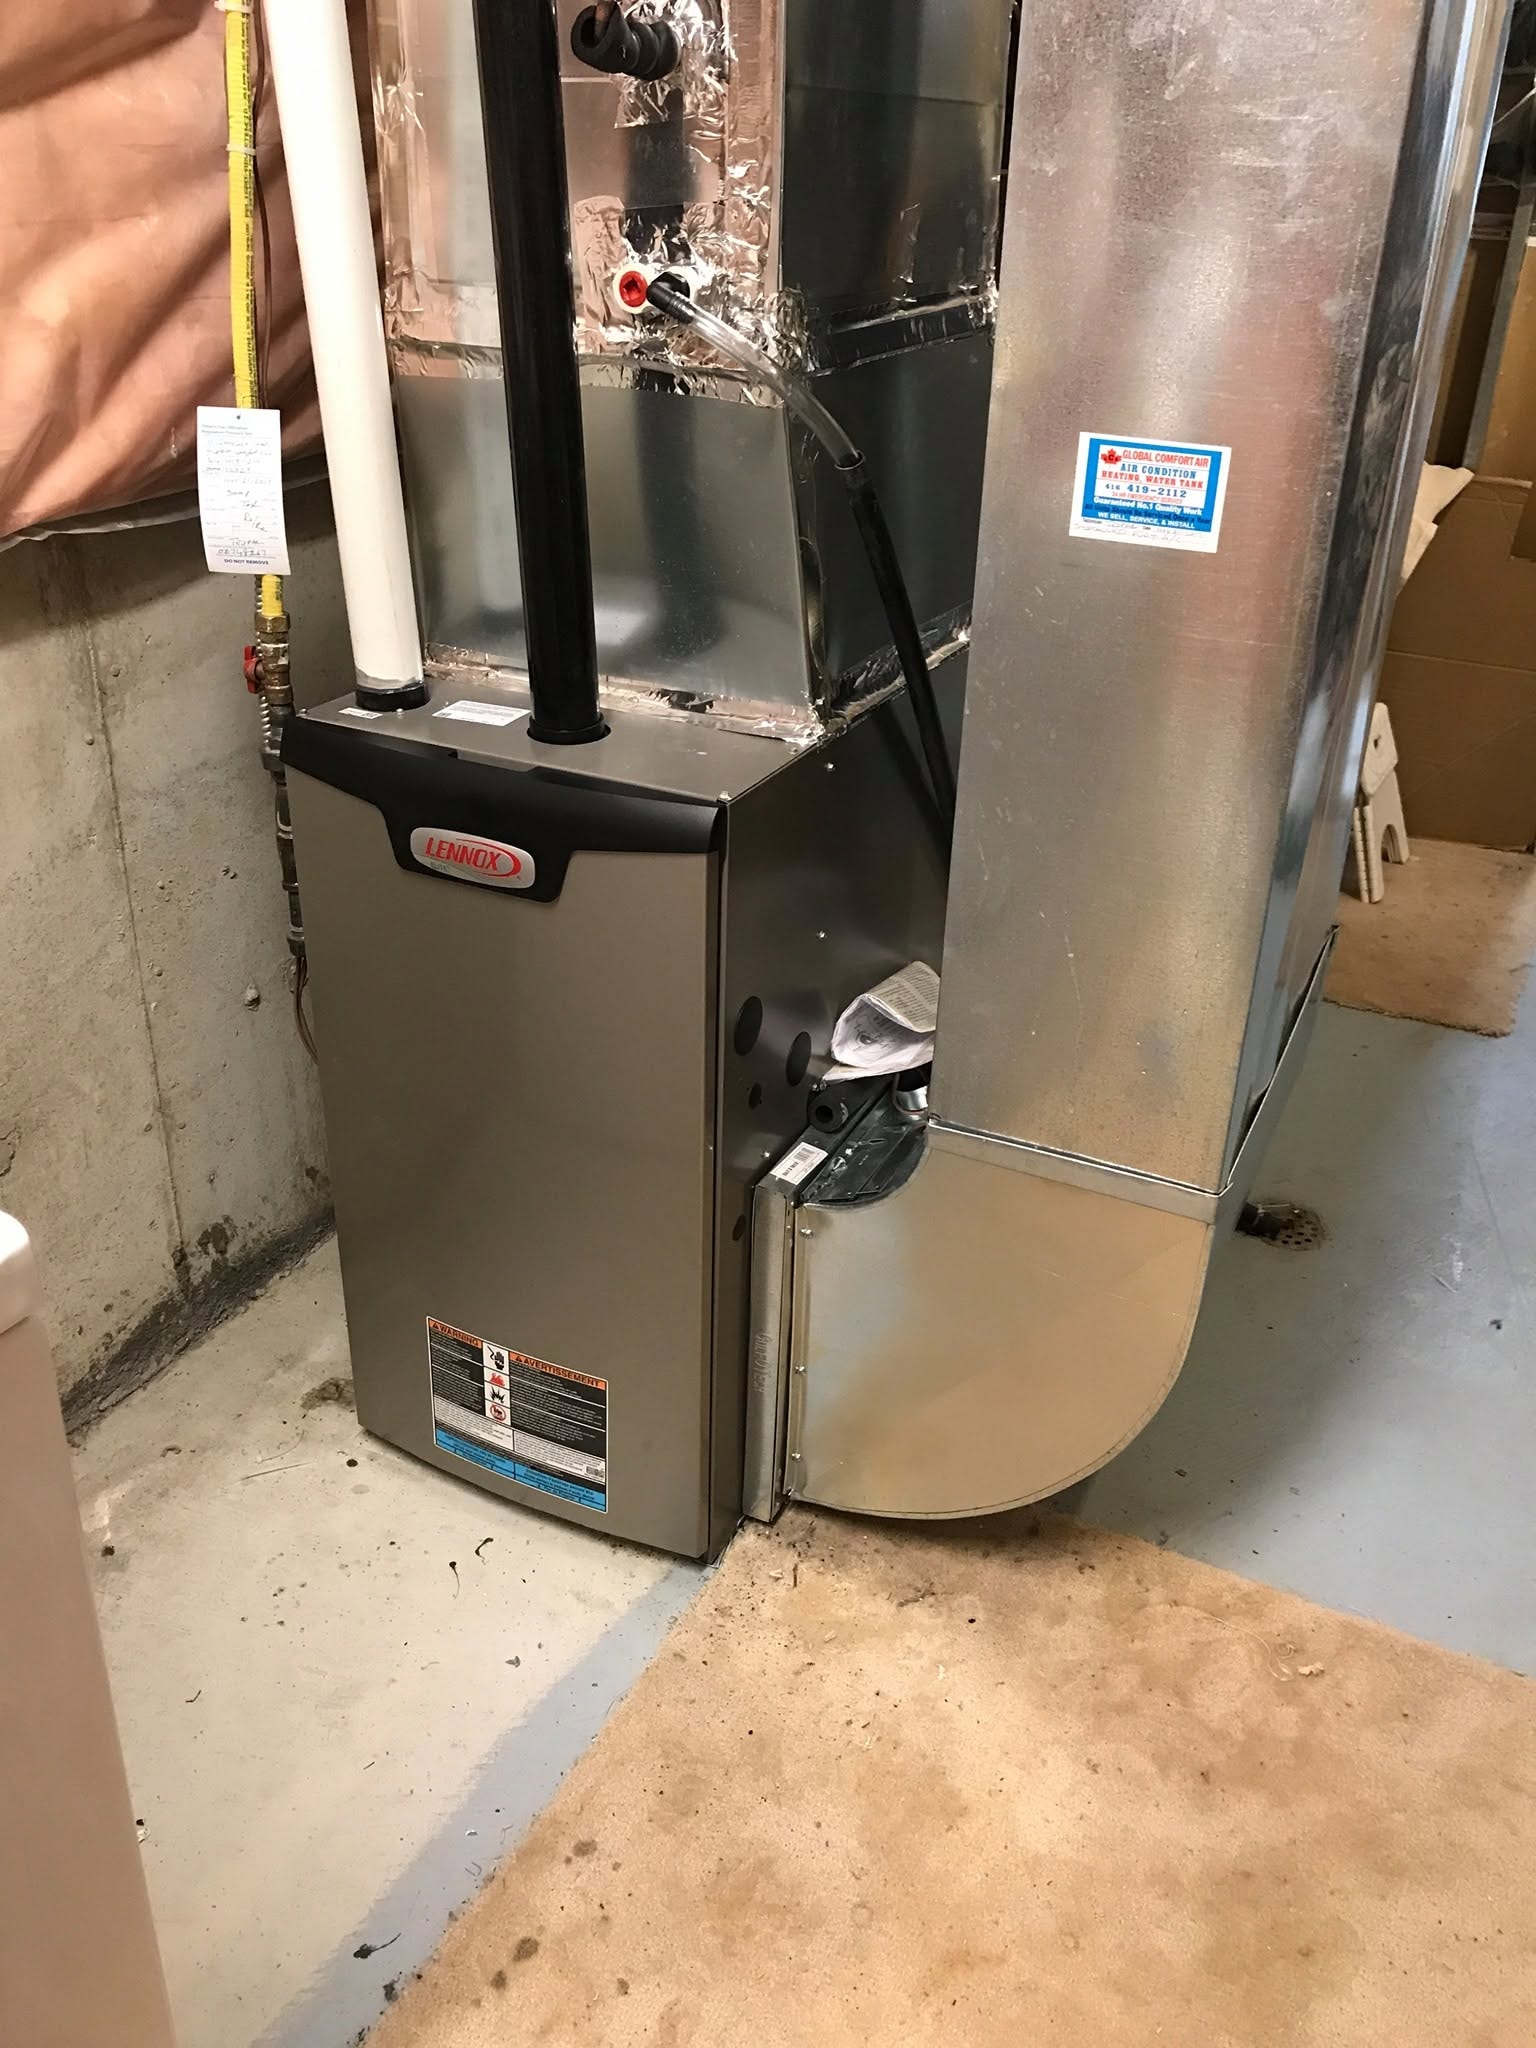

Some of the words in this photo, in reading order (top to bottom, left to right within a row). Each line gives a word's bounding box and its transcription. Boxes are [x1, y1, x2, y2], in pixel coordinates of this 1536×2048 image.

[1122, 449, 1153, 462] GLOBAL
[1155, 453, 1194, 466] COMFORT
[1194, 457, 1209, 467] AIR
[1120, 463, 1138, 472] AIR
[1141, 466, 1197, 479] CONDITION
[1145, 475, 1176, 486] WATER
[1179, 479, 1204, 488] TANK
[1127, 484, 1187, 498] 419-2112
[1093, 496, 1136, 509] Guaranteed
[1137, 501, 1153, 510] No.1
[1155, 503, 1182, 515] Quality
[1183, 507, 1203, 516] Work
[1097, 511, 1109, 519] WE
[1110, 513, 1128, 522] SELL,
[1129, 515, 1160, 526] SERVICE,
[1167, 520, 1195, 529] INSTALL
[425, 836, 501, 871] LENNOX
[439, 1324, 479, 1347] WARNING
[524, 1358, 600, 1387] AVERTISSEMENT
